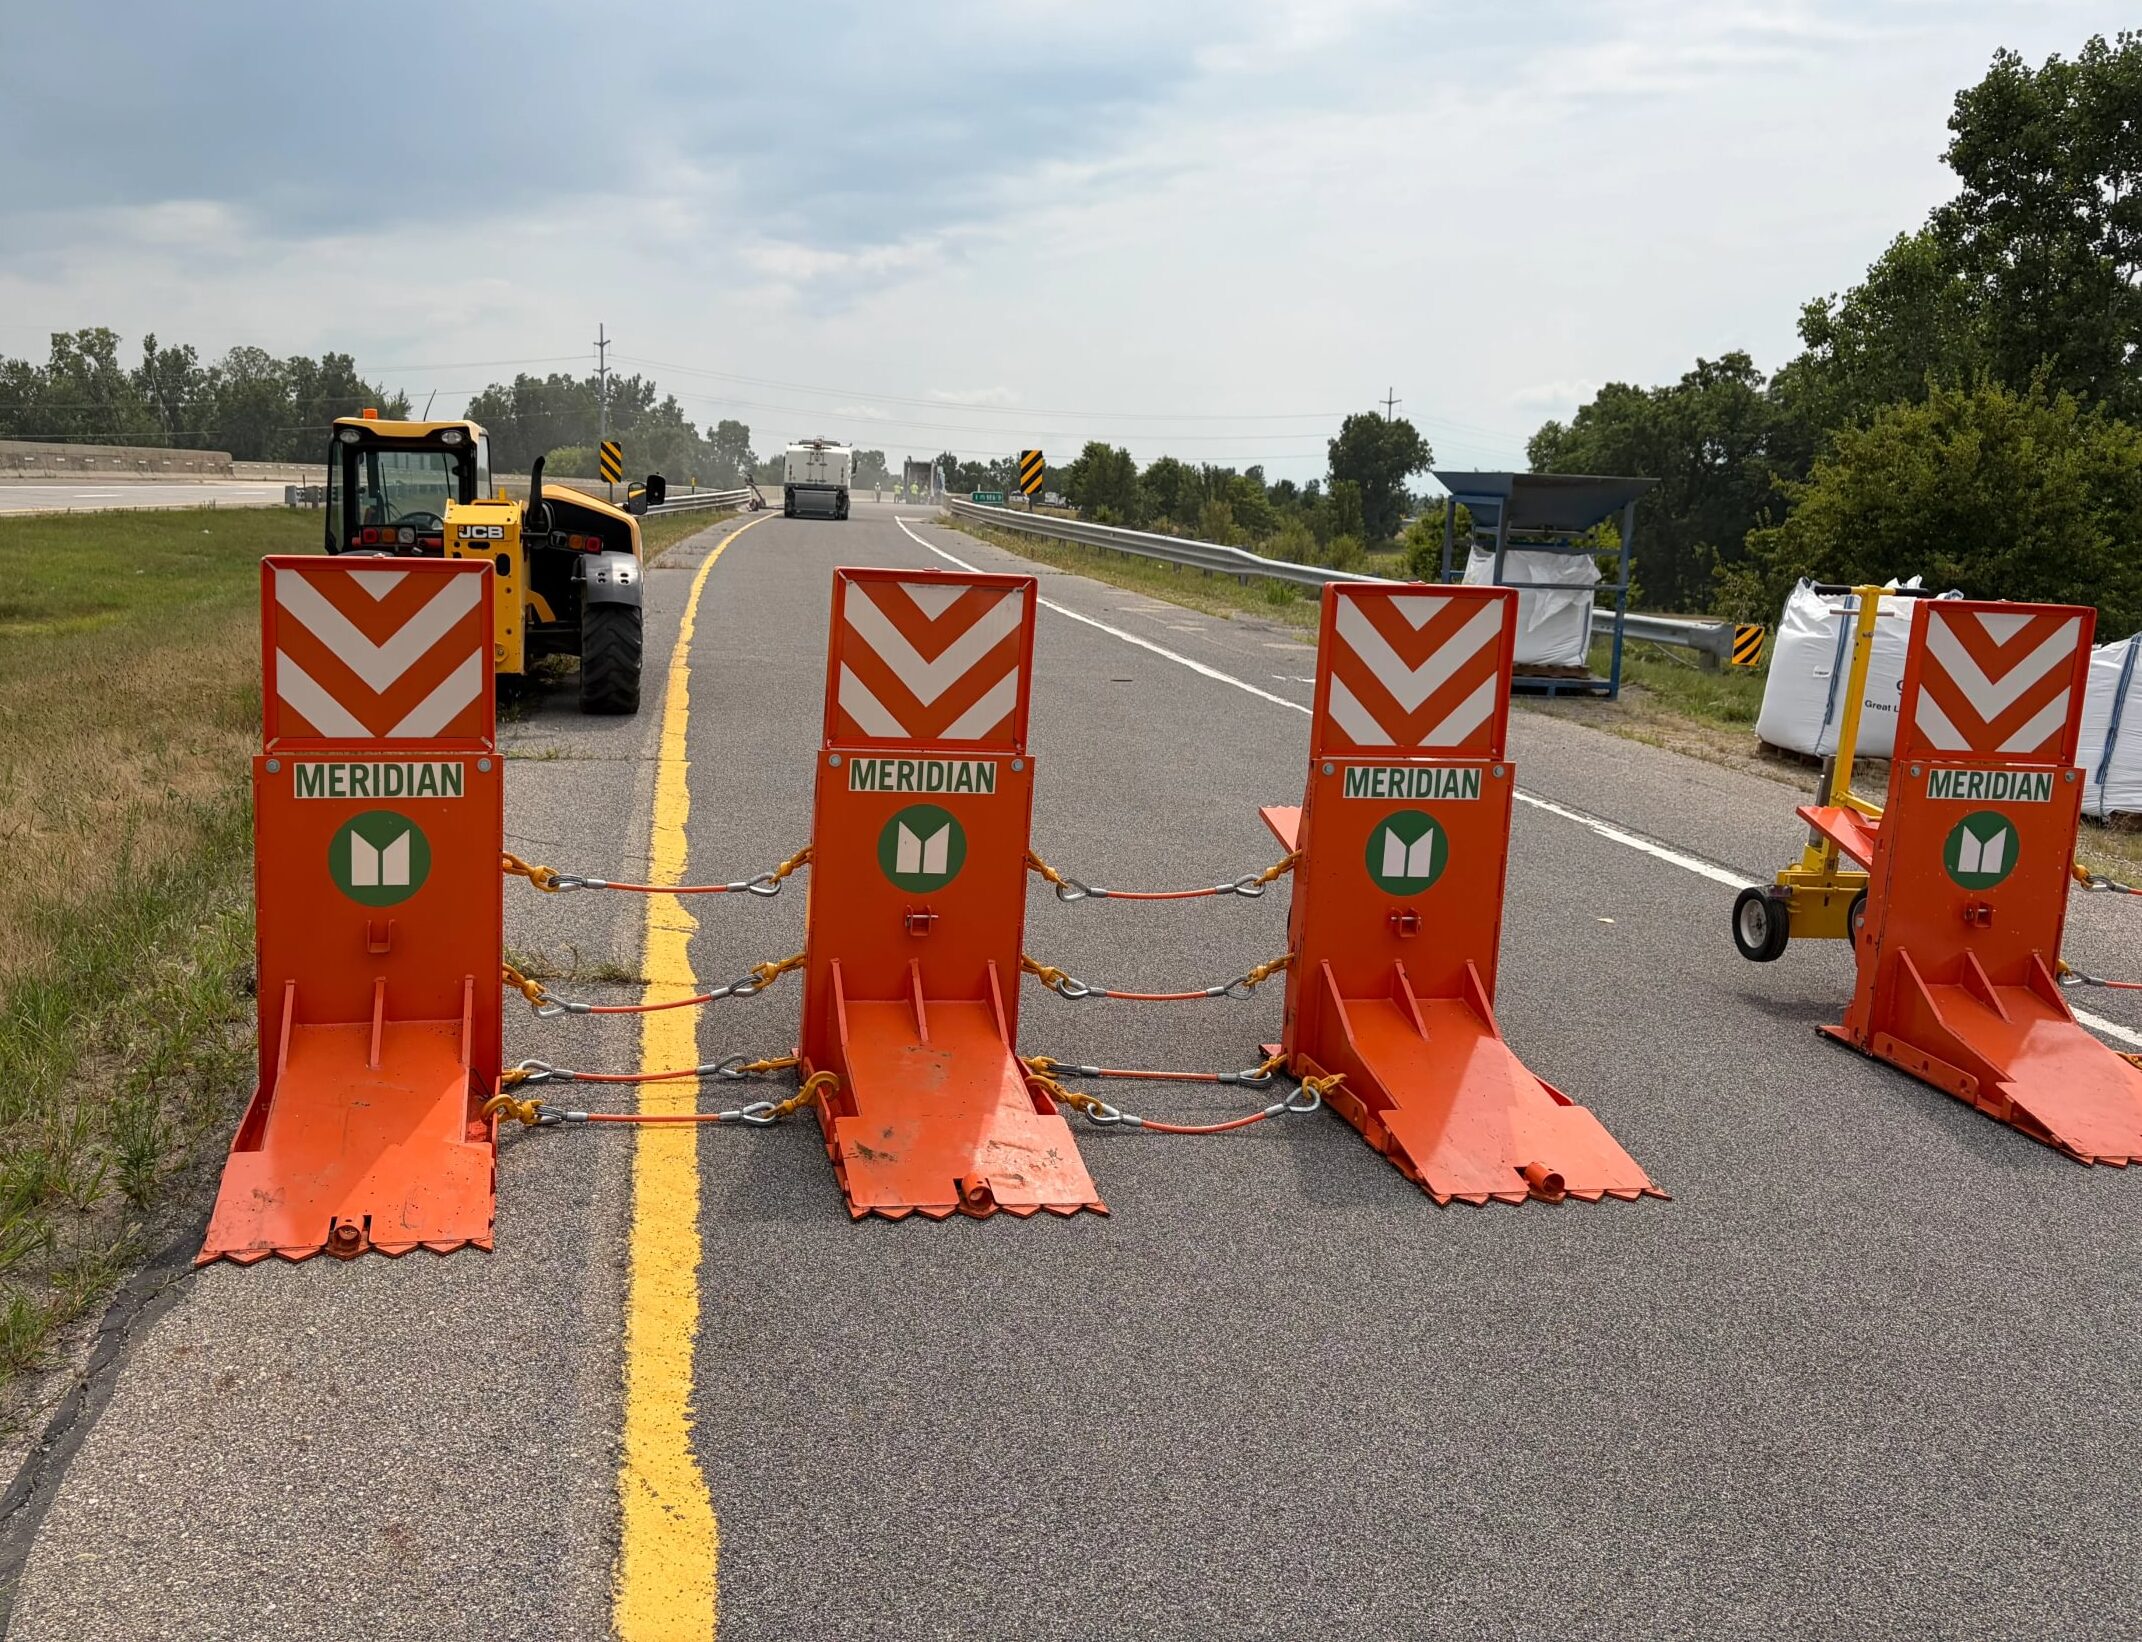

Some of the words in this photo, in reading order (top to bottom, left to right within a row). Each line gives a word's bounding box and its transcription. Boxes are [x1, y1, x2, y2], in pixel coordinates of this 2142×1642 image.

[458, 525, 503, 539] JCB
[1864, 699, 1891, 712] Great
[295, 763, 463, 798] MERIDIAN
[850, 759, 995, 793] MERIDIAN
[1344, 767, 1481, 799] MERIDIAN
[1928, 770, 2053, 801] MERIDIAN
